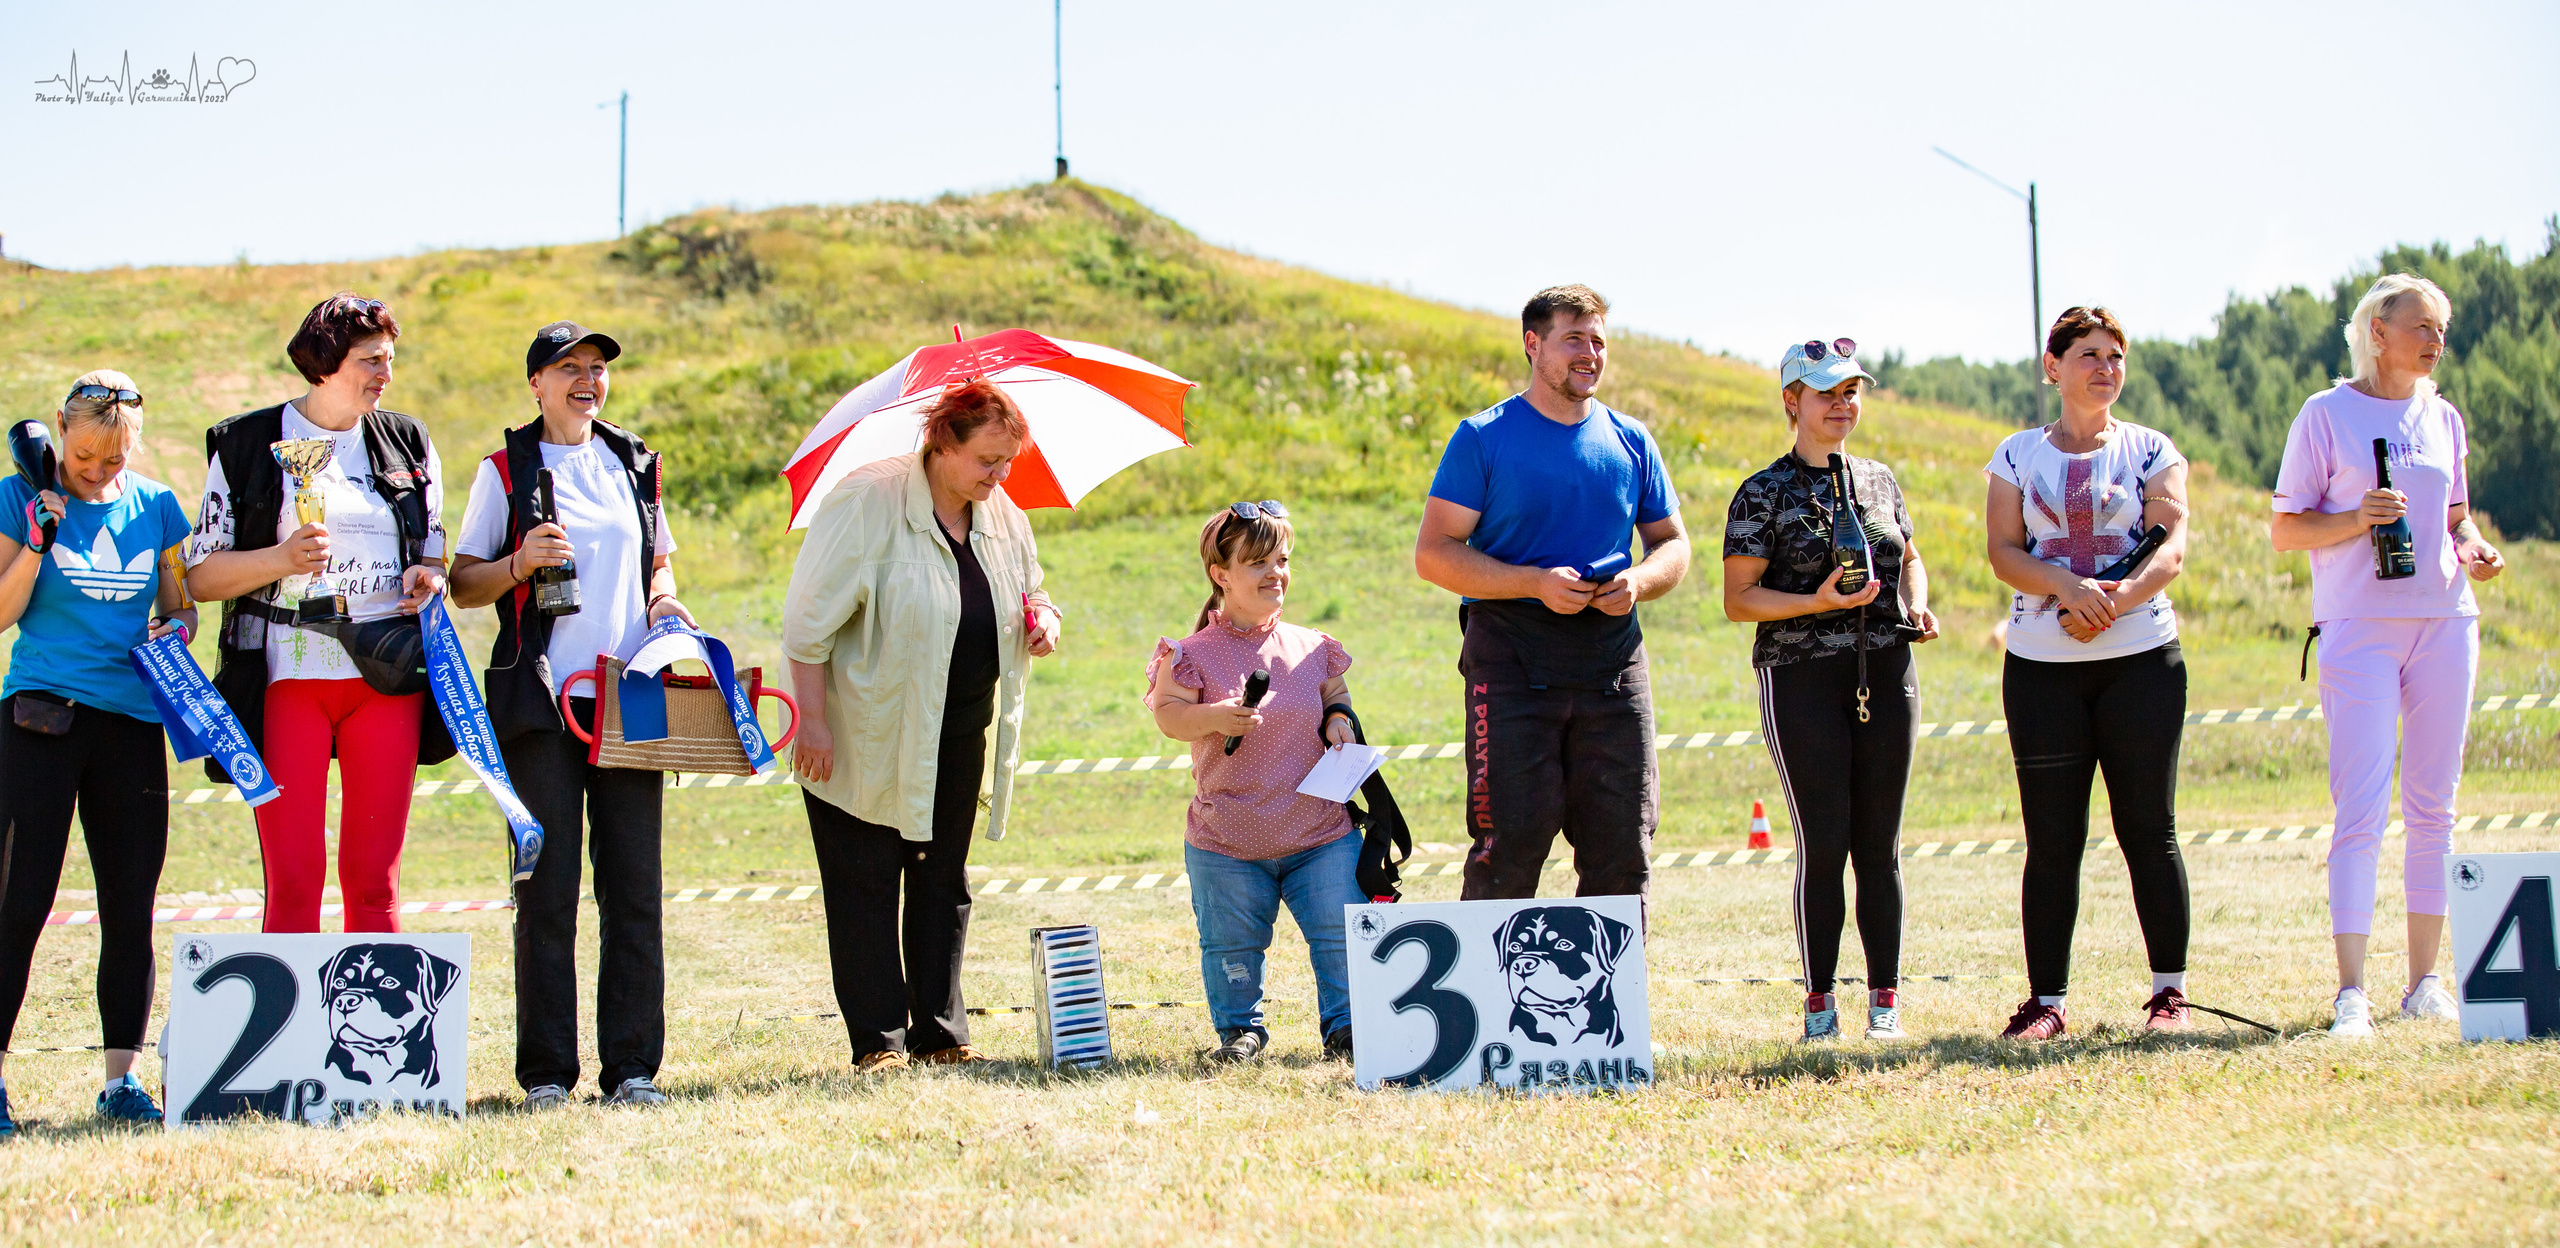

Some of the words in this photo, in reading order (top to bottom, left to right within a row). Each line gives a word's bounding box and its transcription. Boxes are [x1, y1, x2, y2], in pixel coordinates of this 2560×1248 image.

[326, 554, 363, 574] Lets
[137, 648, 161, 680] августа
[158, 680, 175, 700] 2022
[167, 639, 205, 691] Чемпионат
[219, 713, 248, 749] Рязани»
[172, 680, 220, 738] Участник
[434, 662, 466, 717] Лучшая
[460, 719, 485, 769] собака
[439, 627, 484, 710] Межрегиональный
[474, 709, 499, 765] Чемпионат
[440, 701, 448, 711] 13
[445, 711, 463, 744] августа
[1371, 920, 1478, 1088] 3
[2462, 876, 2560, 1038] 4
[182, 952, 299, 1122] 2
